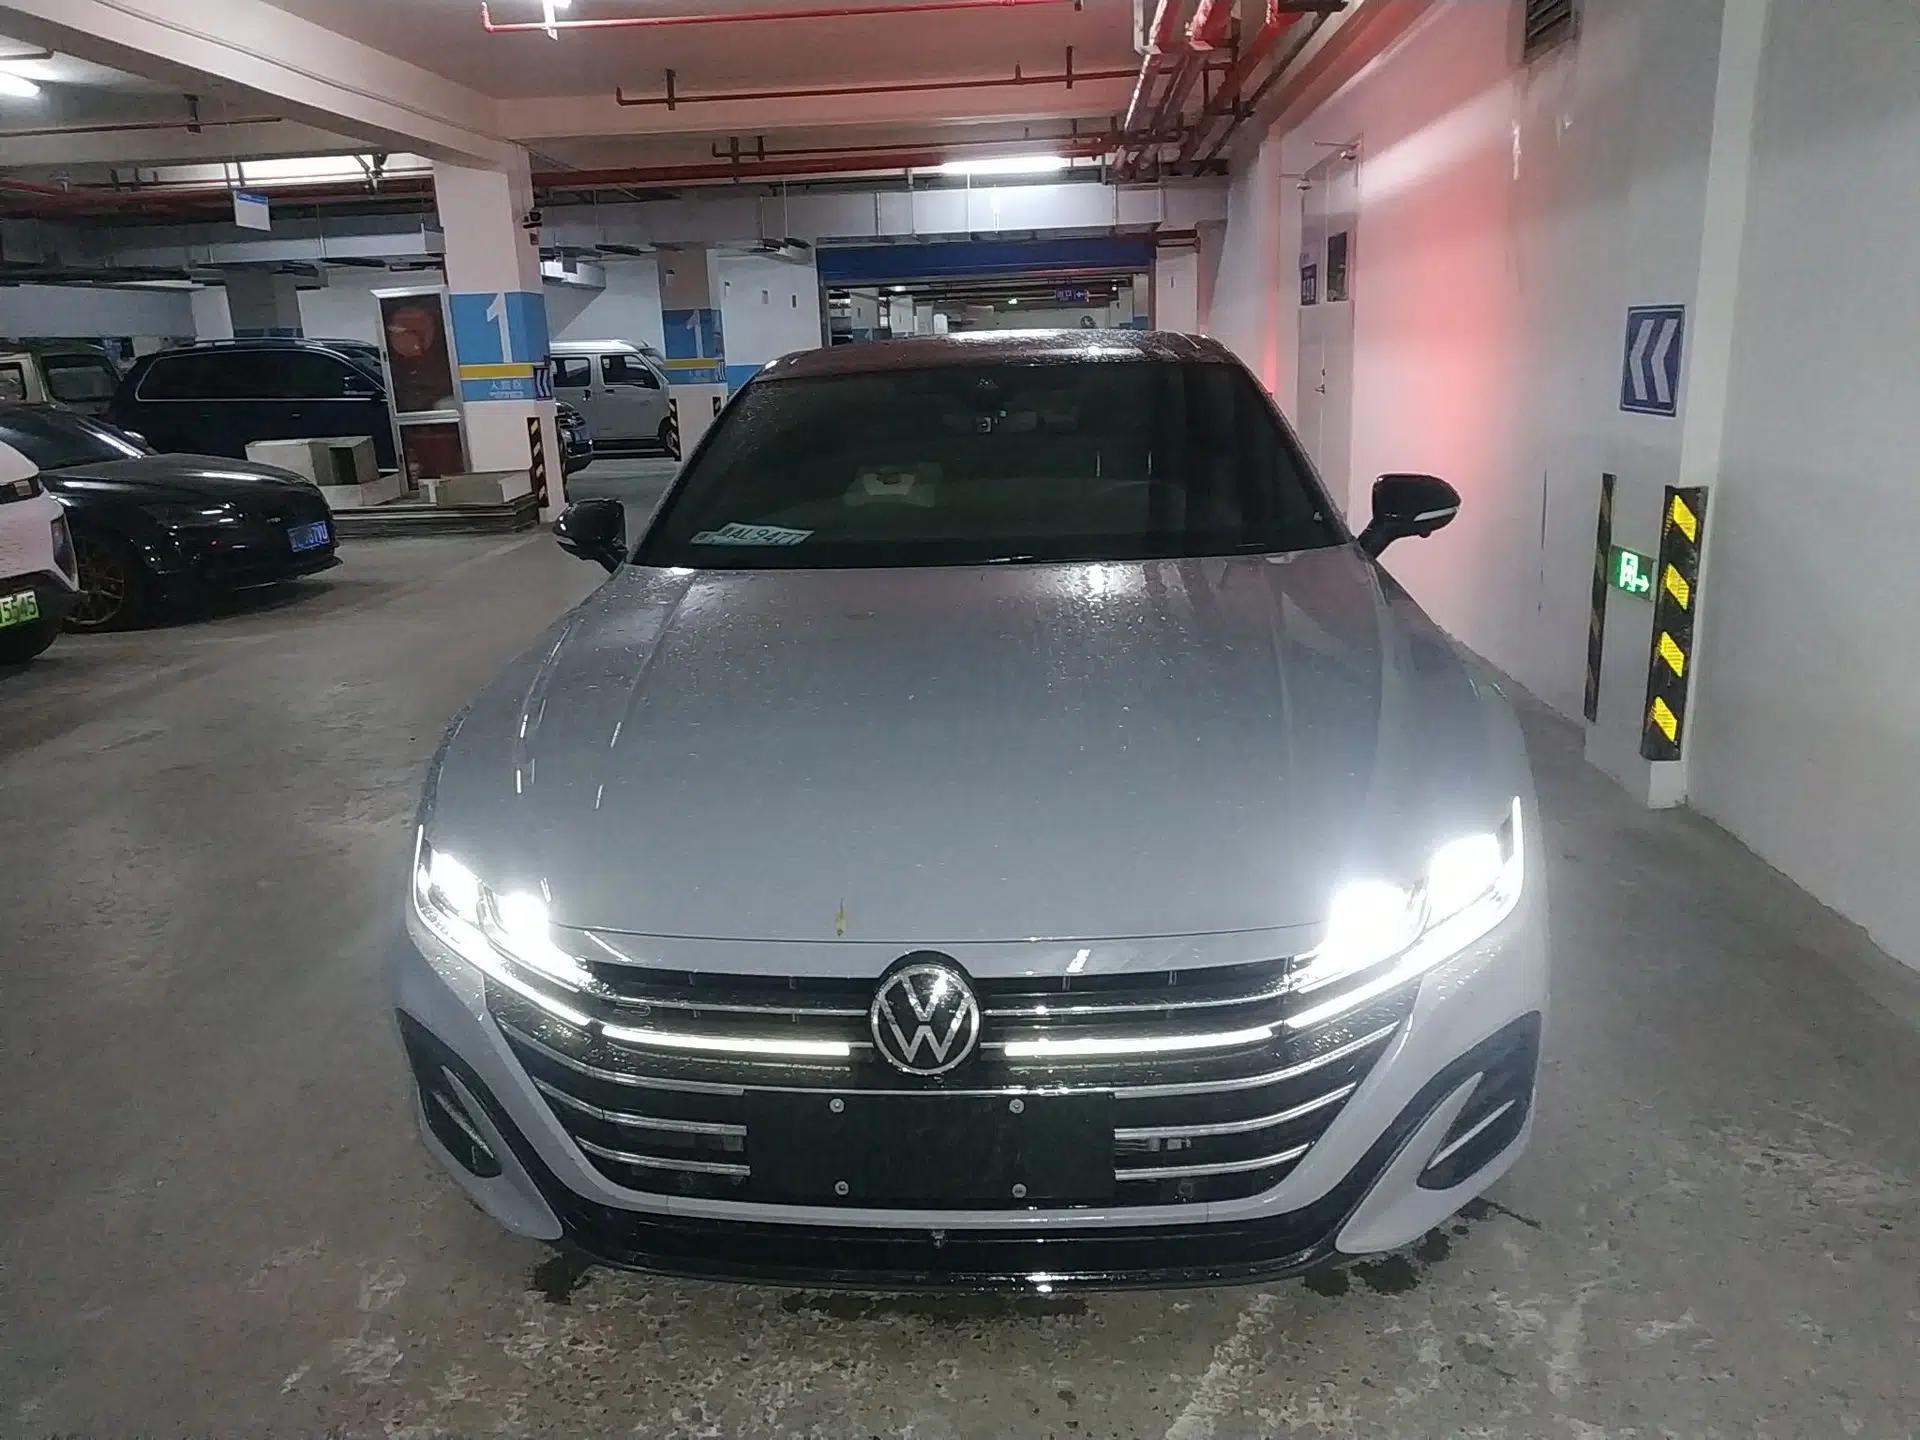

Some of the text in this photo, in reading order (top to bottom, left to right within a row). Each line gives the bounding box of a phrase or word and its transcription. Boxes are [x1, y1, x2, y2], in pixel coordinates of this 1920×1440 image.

[486, 293, 512, 362] 1
[686, 310, 703, 358] 1
[876, 967, 973, 1068] VW
